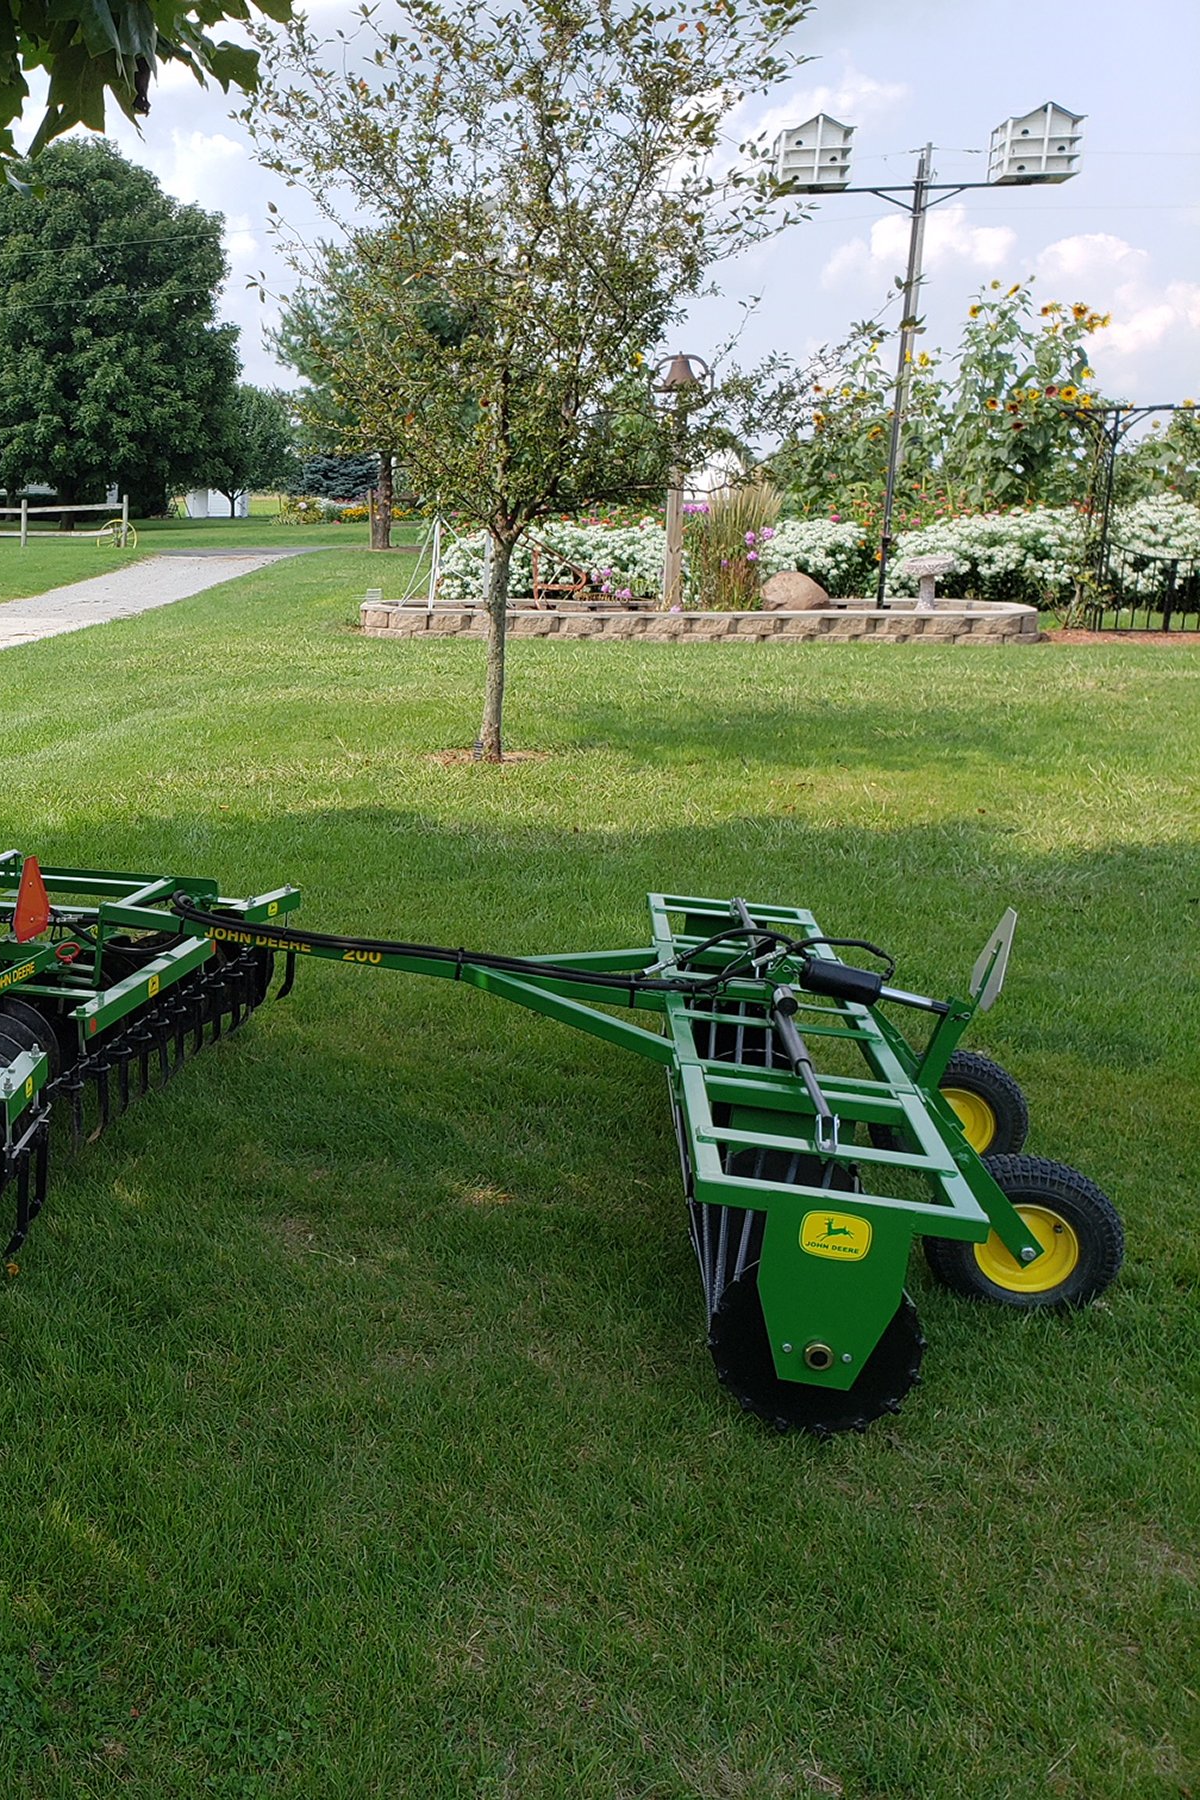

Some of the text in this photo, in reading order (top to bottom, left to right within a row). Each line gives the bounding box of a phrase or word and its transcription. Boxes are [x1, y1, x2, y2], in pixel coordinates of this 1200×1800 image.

[204, 926, 382, 964] JOHN DEERE 200
[12, 961, 36, 983] DEERE
[805, 1241, 860, 1254] JOHN DEERE
